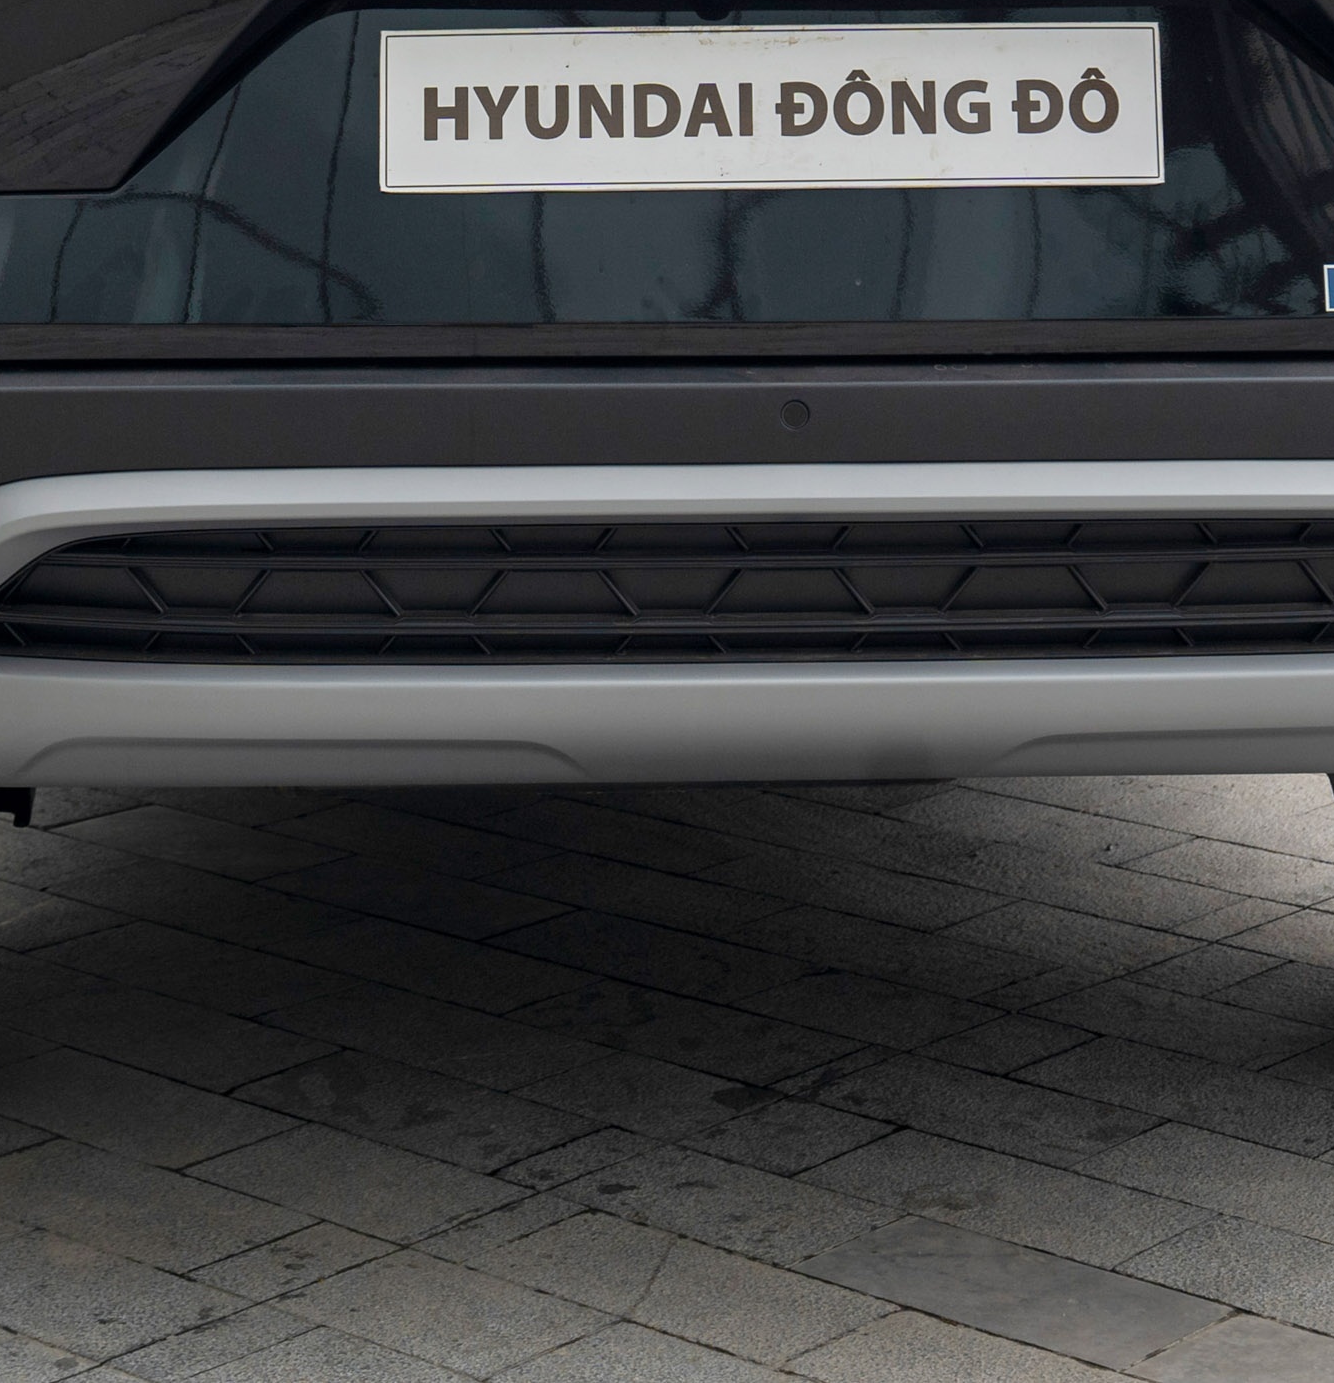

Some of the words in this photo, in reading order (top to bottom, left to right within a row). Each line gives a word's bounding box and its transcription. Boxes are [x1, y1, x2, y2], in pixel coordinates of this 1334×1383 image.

[421, 82, 754, 143] HYUNDAI
[775, 69, 992, 138] ĐÔNG
[1012, 67, 1120, 134] ĐÔ
